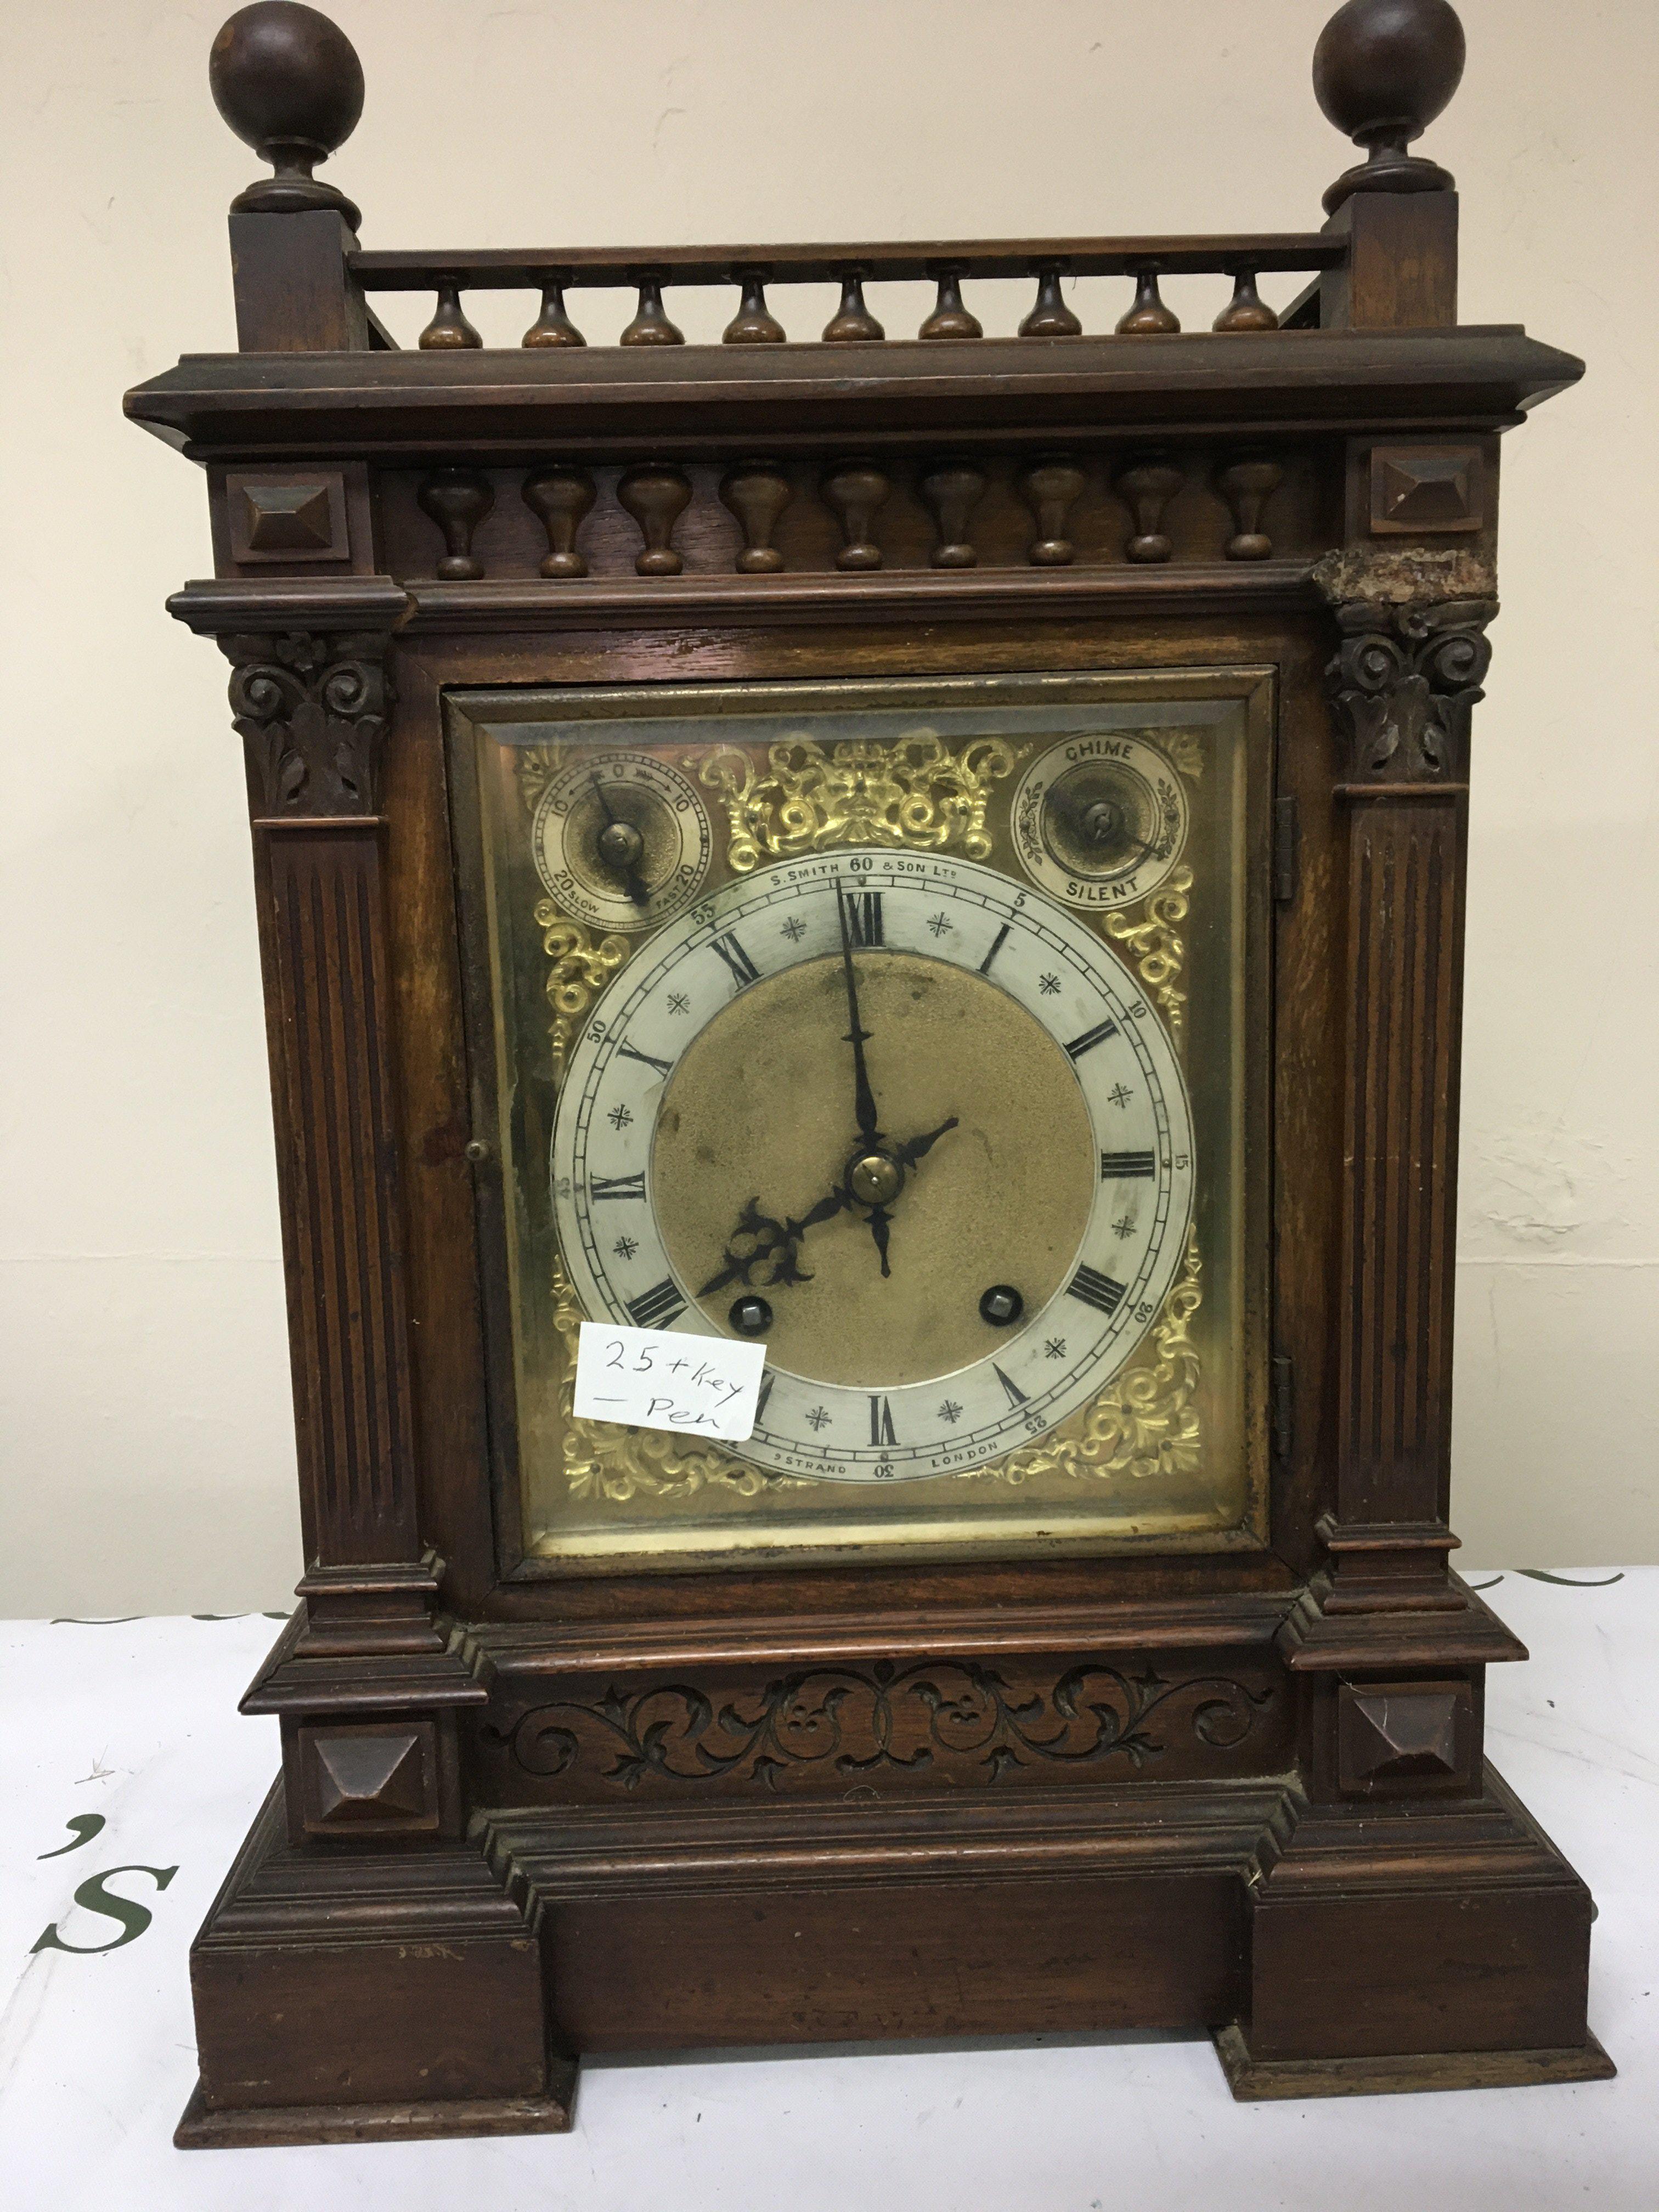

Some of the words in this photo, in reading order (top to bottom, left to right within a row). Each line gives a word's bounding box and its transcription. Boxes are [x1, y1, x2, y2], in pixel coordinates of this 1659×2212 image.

[1065, 741, 1133, 761] CHIME
[551, 800, 568, 818] 10
[673, 793, 690, 813] 10
[676, 864, 694, 885] 20
[850, 857, 873, 872] 60
[883, 862, 895, 871] &
[898, 861, 926, 872] SON
[554, 870, 574, 891] 20
[1066, 877, 1138, 901] SILENT
[568, 891, 600, 913] SLOW
[656, 887, 681, 908] FAST
[1014, 893, 1026, 907] 5
[691, 904, 716, 926] 55
[706, 928, 765, 992] XI
[1128, 1000, 1147, 1019] 10
[586, 1020, 607, 1043] 50
[1062, 1015, 1121, 1064] II
[615, 1035, 674, 1081] X
[1101, 1147, 1155, 1183] III
[1175, 1154, 1188, 1170] 15
[590, 1170, 647, 1205] IX
[1064, 1260, 1129, 1319] IIII
[1134, 1302, 1153, 1323] 20
[606, 1341, 659, 1372] 25
[991, 1362, 1031, 1411] V
[867, 1395, 901, 1447] VI
[1025, 1414, 1047, 1435] 25
[931, 1441, 998, 1468] LONDON
[786, 1457, 846, 1474] STRAND
[874, 1464, 895, 1479] 30
